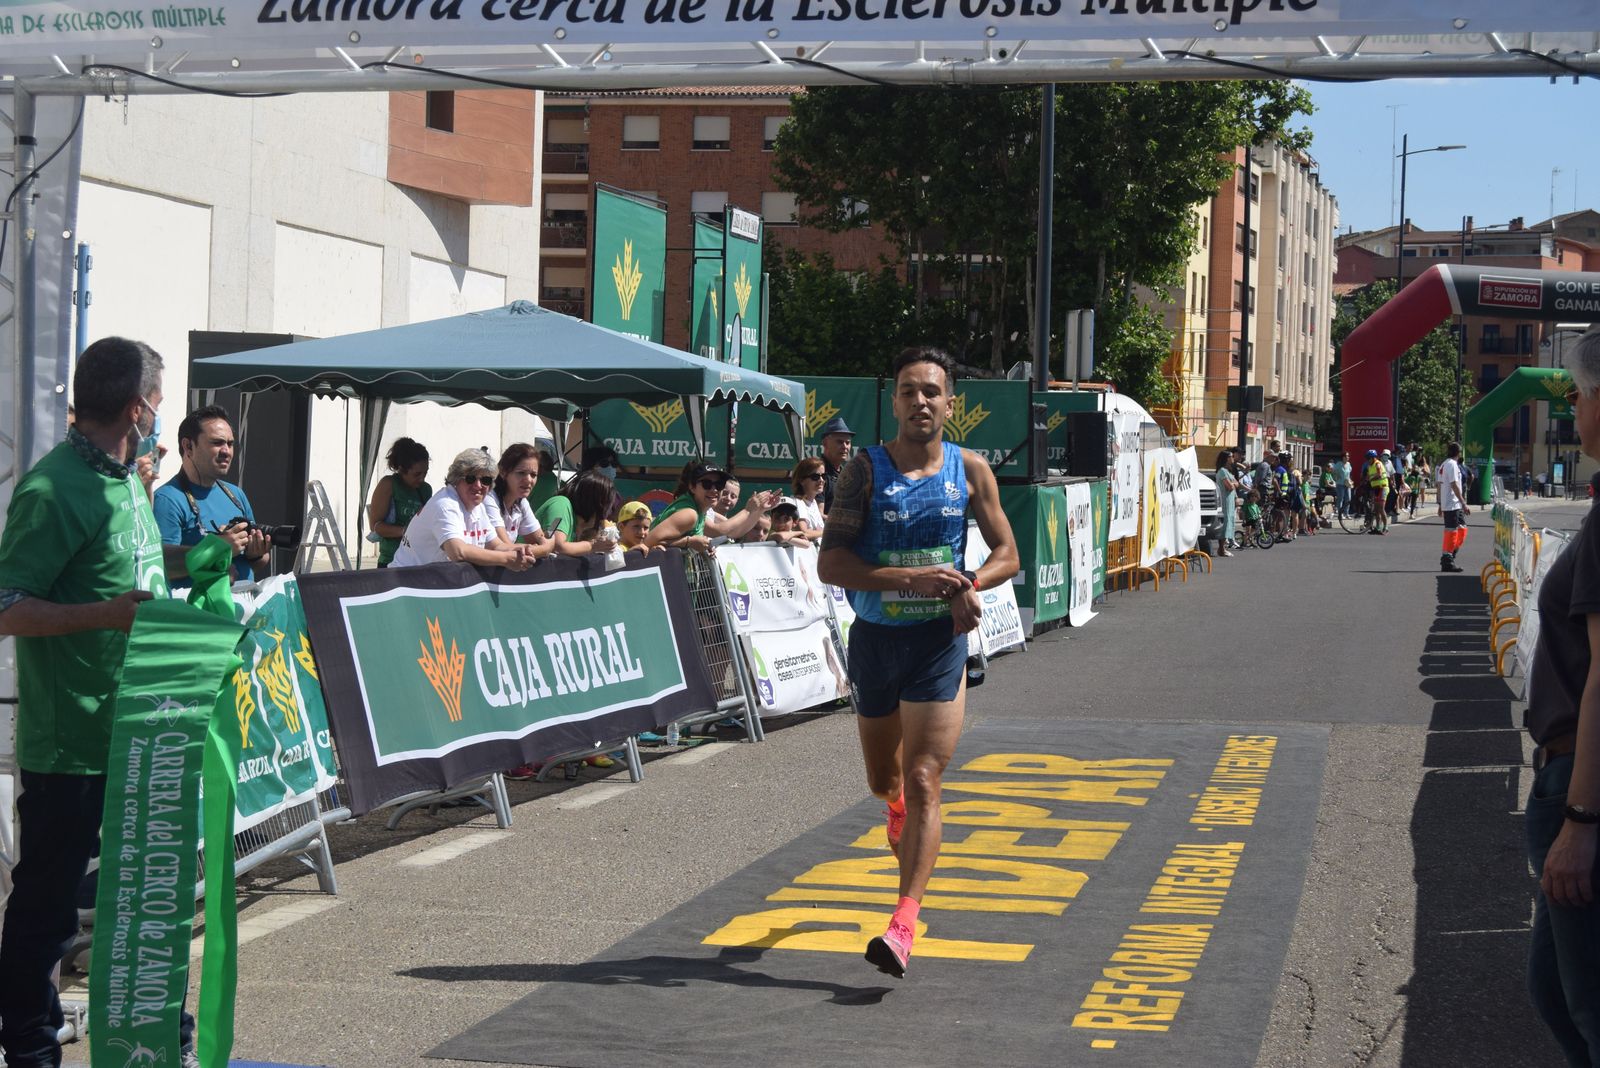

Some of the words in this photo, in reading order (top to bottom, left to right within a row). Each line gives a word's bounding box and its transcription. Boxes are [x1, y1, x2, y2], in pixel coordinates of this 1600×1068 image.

[23, 15, 46, 33] DE
[53, 10, 145, 32] ESCLEROSIS
[152, 5, 227, 28] MÚLTIPLE
[1494, 293, 1538, 304] ZAMORA
[1555, 281, 1587, 293] CON
[747, 443, 794, 459] CAJA
[474, 637, 552, 708] CAJA
[543, 622, 644, 696] RURAL
[124, 736, 149, 794] Zamora
[148, 732, 189, 816] CARRERA
[122, 798, 139, 840] cerca
[146, 820, 183, 847] del
[117, 866, 139, 884] la
[119, 845, 140, 862] de
[1139, 841, 1246, 916] INTEGRAL
[141, 852, 180, 915] CERCO
[112, 886, 137, 961] Esclerosis
[138, 920, 177, 940] de
[106, 964, 130, 1028] Múltiple
[131, 946, 173, 1028] ZAMORA
[1071, 923, 1215, 1032] REFORMA
